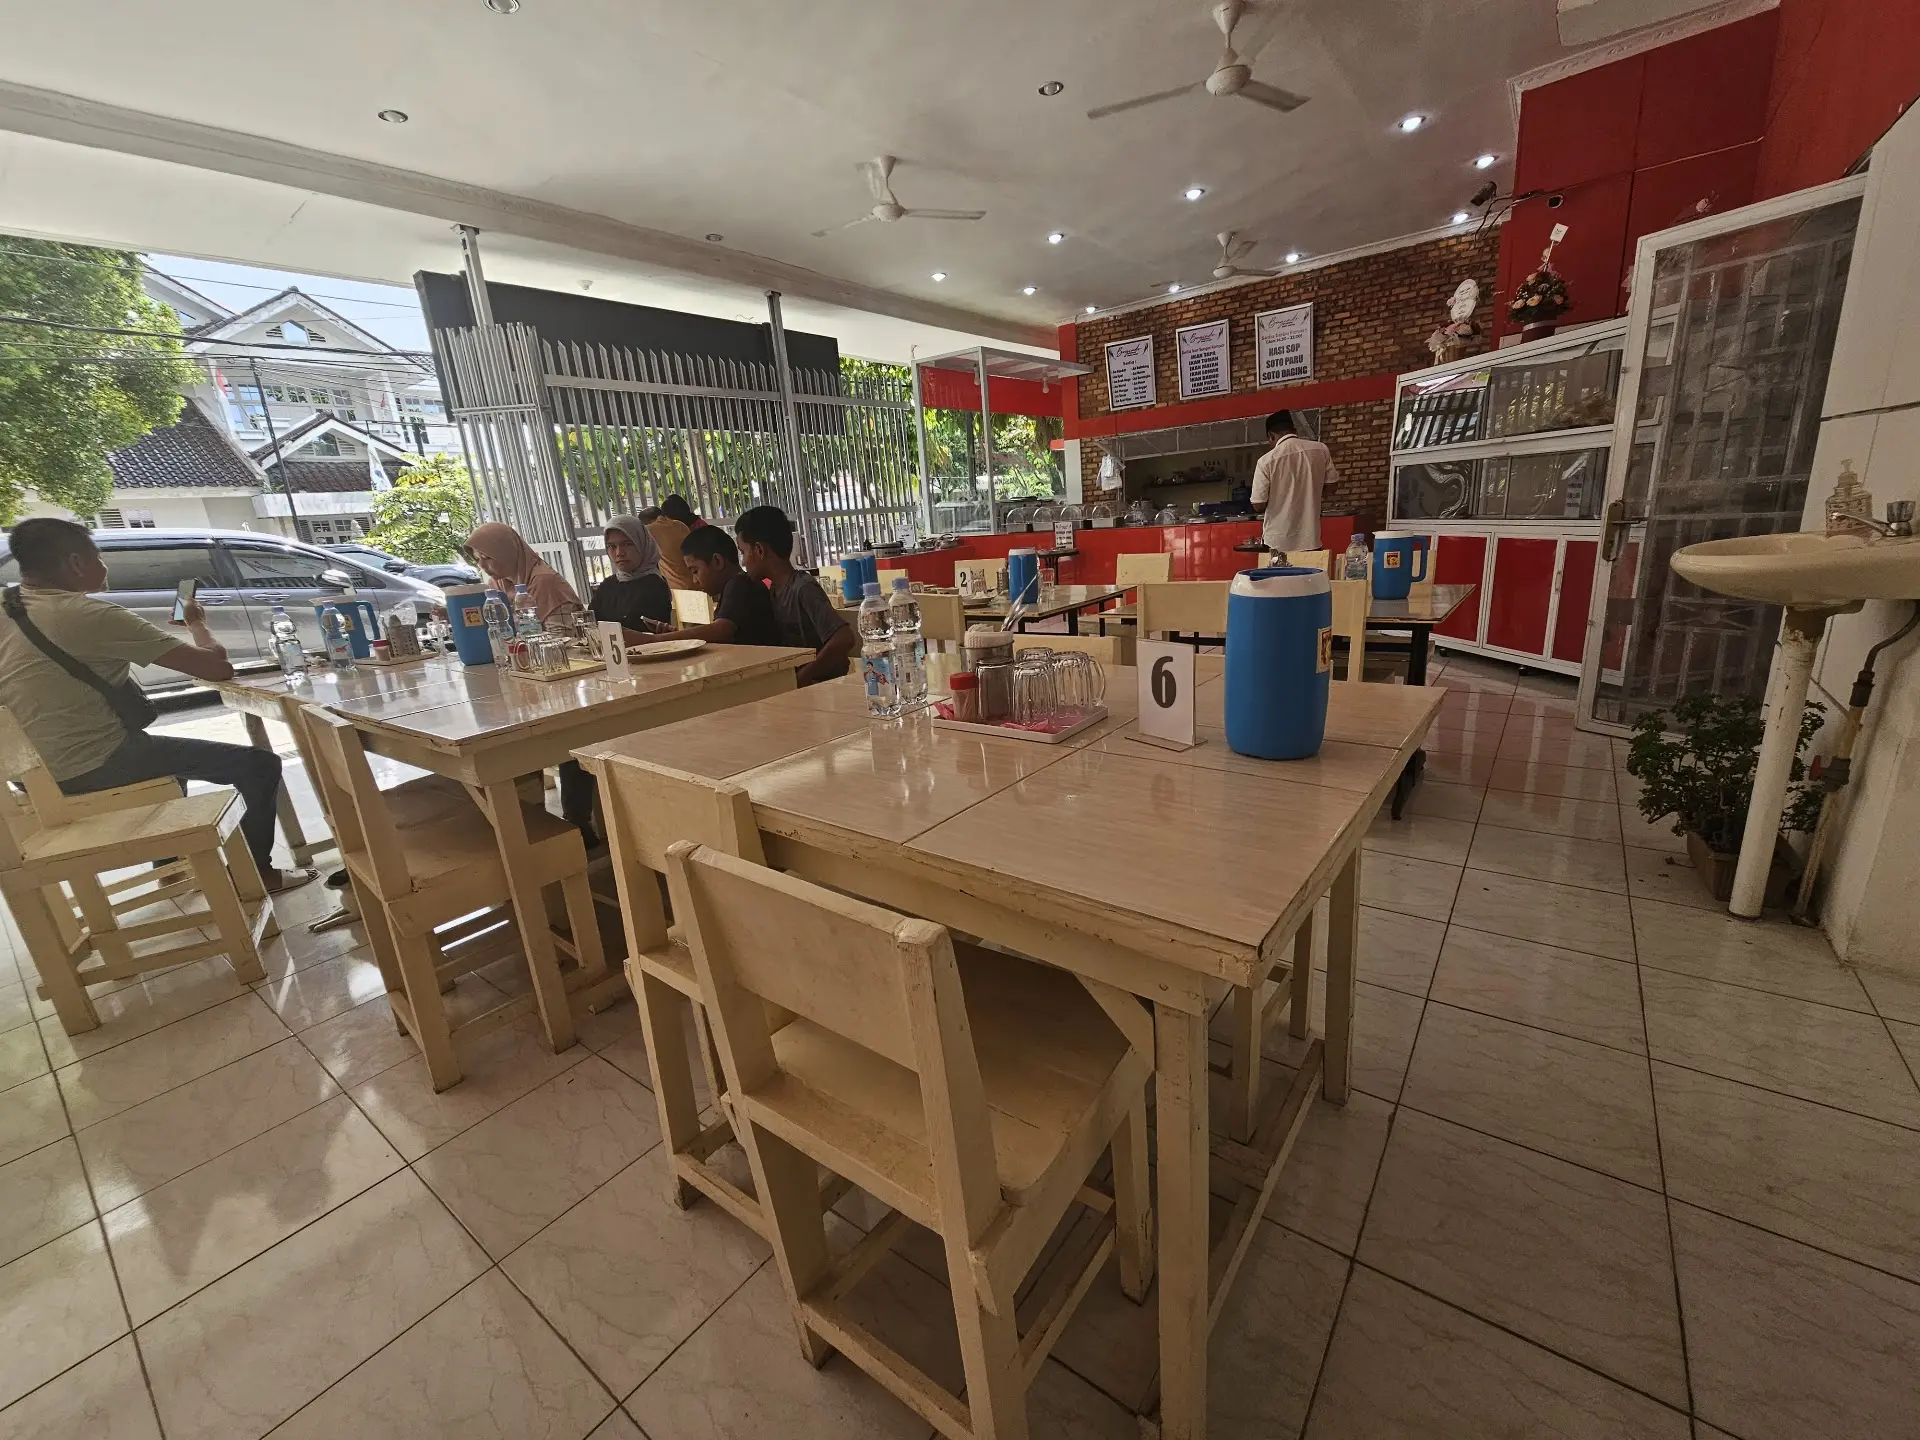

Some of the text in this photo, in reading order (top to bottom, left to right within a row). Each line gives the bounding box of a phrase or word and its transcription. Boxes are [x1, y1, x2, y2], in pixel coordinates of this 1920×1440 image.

[1269, 343, 1300, 356] NASI SOP
[1266, 354, 1304, 369] SOTO PARU
[1262, 366, 1308, 381] SOTO DAGING
[960, 571, 968, 587] 2
[609, 633, 622, 665] 5
[1151, 655, 1177, 709] 6
